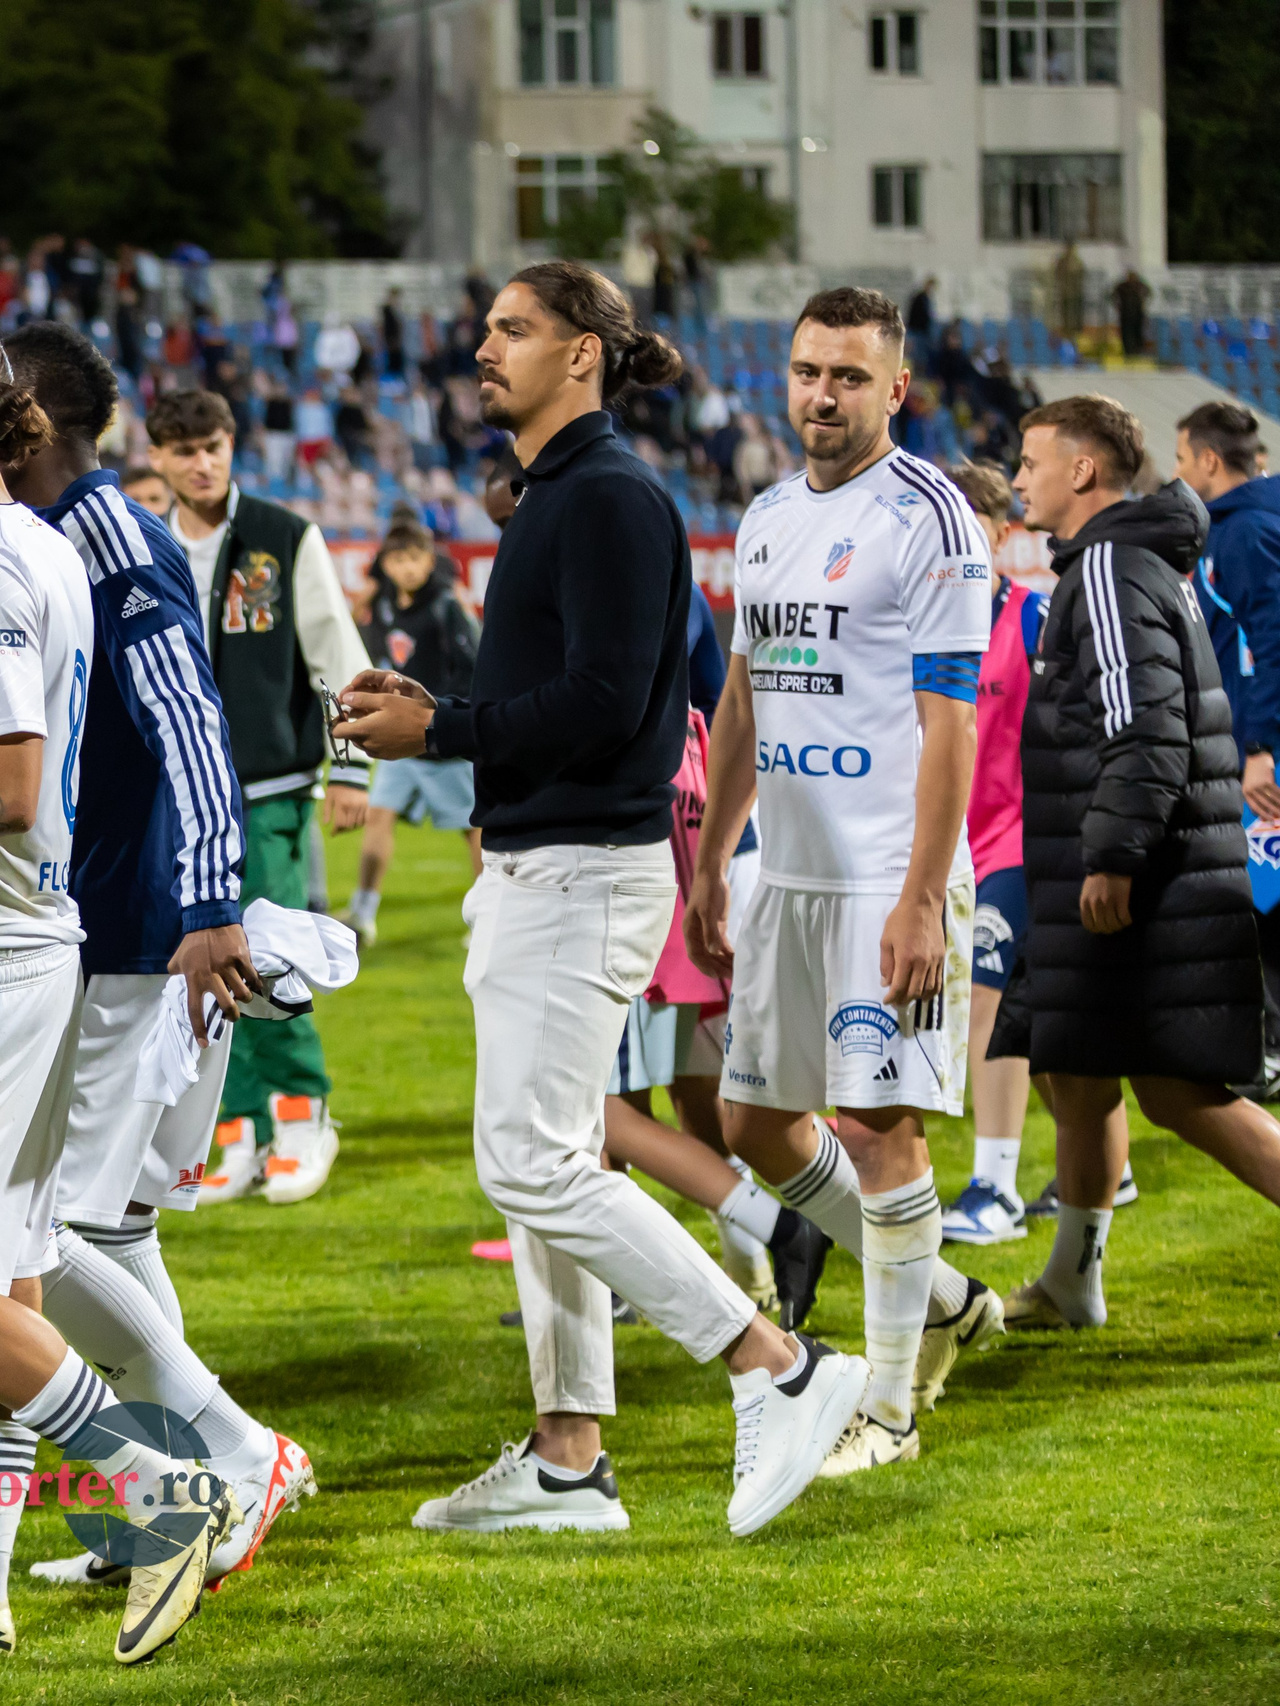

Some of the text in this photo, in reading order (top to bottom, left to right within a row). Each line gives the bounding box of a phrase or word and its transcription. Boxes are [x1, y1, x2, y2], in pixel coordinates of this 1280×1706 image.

[121, 599, 159, 618] adidas
[779, 673, 808, 692] SPRE
[810, 676, 835, 694] 0%
[842, 1008, 897, 1035] CONTINENTS
[729, 1067, 767, 1088] Vestra
